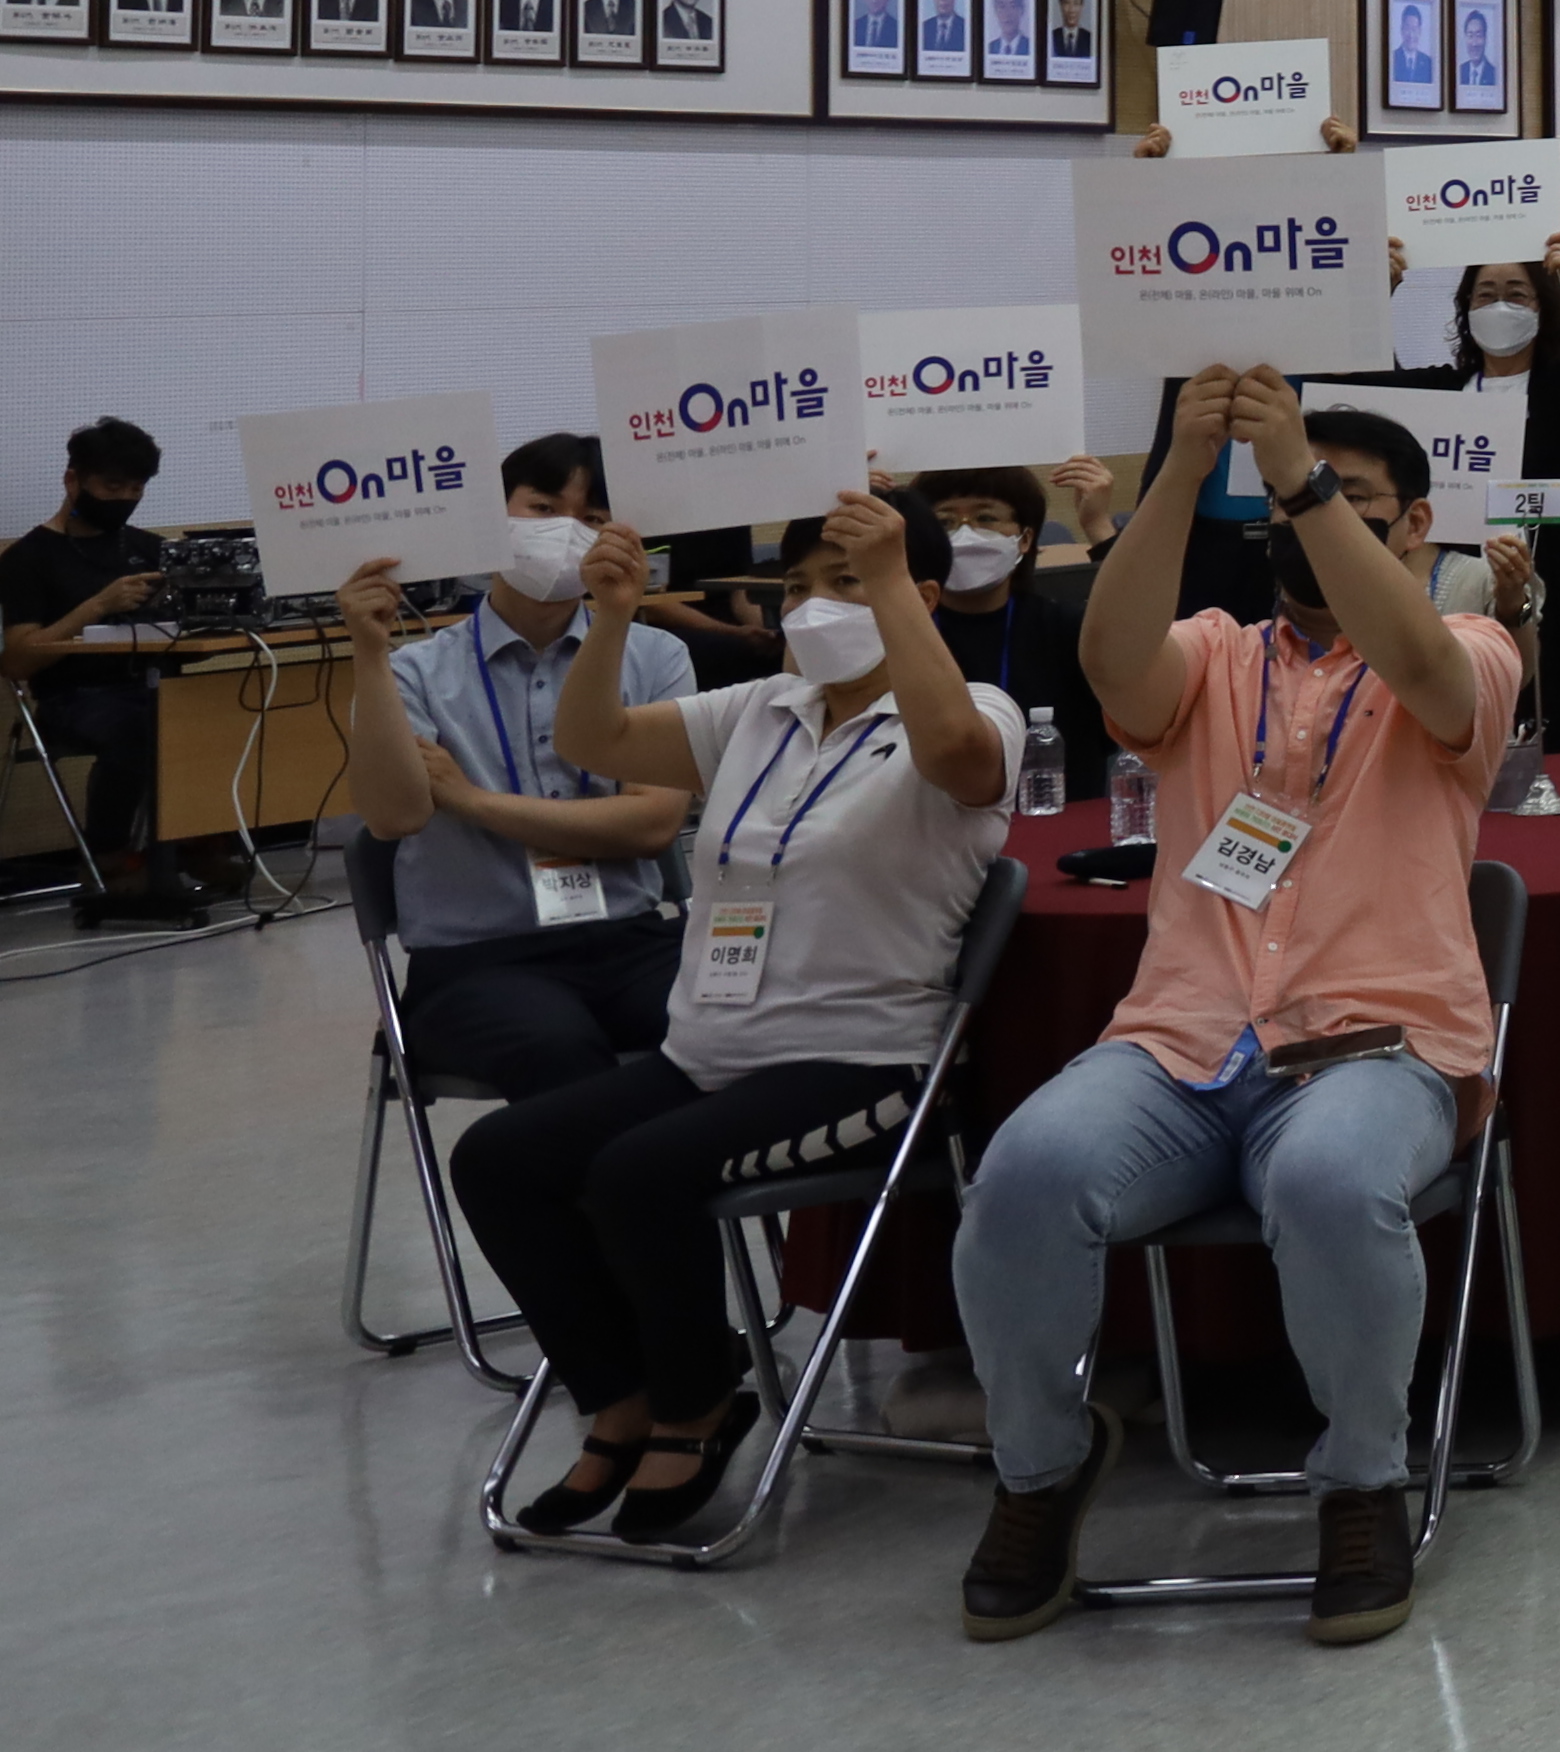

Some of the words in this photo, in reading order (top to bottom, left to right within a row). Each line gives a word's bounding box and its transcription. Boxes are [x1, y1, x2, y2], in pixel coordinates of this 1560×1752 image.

[1110, 244, 1162, 276] 인천
[864, 374, 907, 399] 인천
[628, 408, 676, 442] 인천
[274, 481, 315, 510] 인천
[1217, 836, 1276, 875] 김경남
[541, 872, 591, 893] 박지상
[710, 946, 758, 965] 이명희
